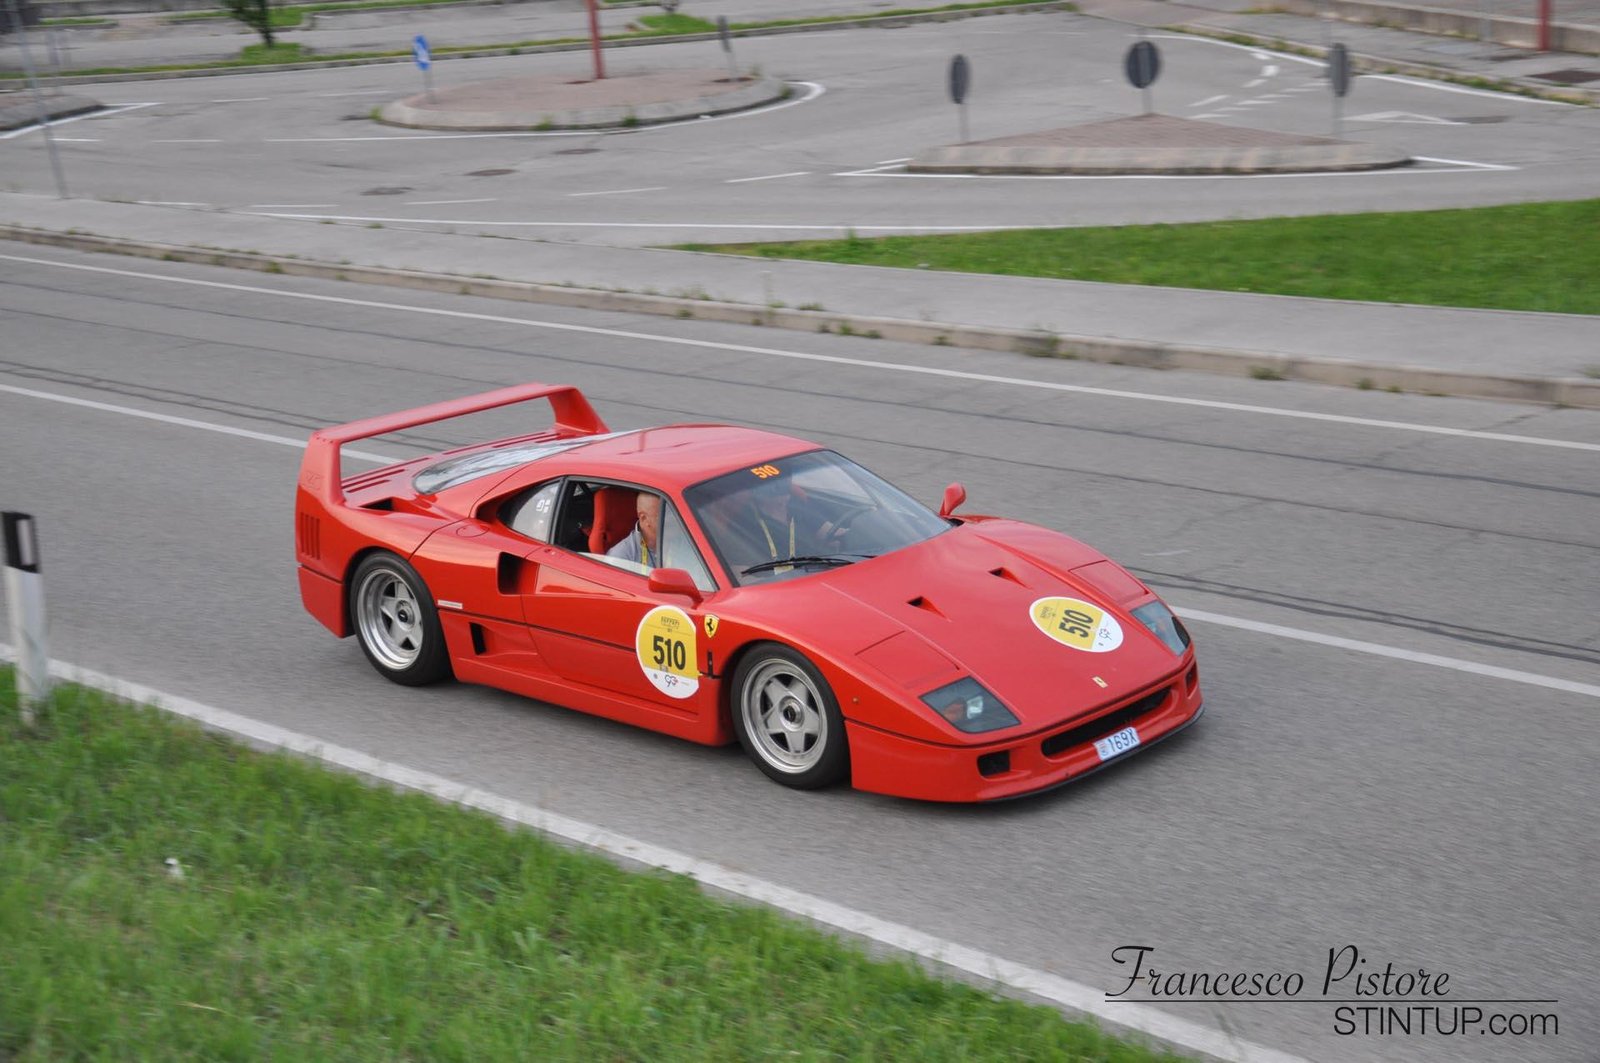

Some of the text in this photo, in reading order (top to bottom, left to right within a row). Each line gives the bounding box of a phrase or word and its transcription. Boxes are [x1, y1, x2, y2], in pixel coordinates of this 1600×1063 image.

[751, 464, 780, 479] 510
[1058, 609, 1094, 638] 510
[653, 635, 686, 671] 510
[1107, 728, 1137, 752] 169X
